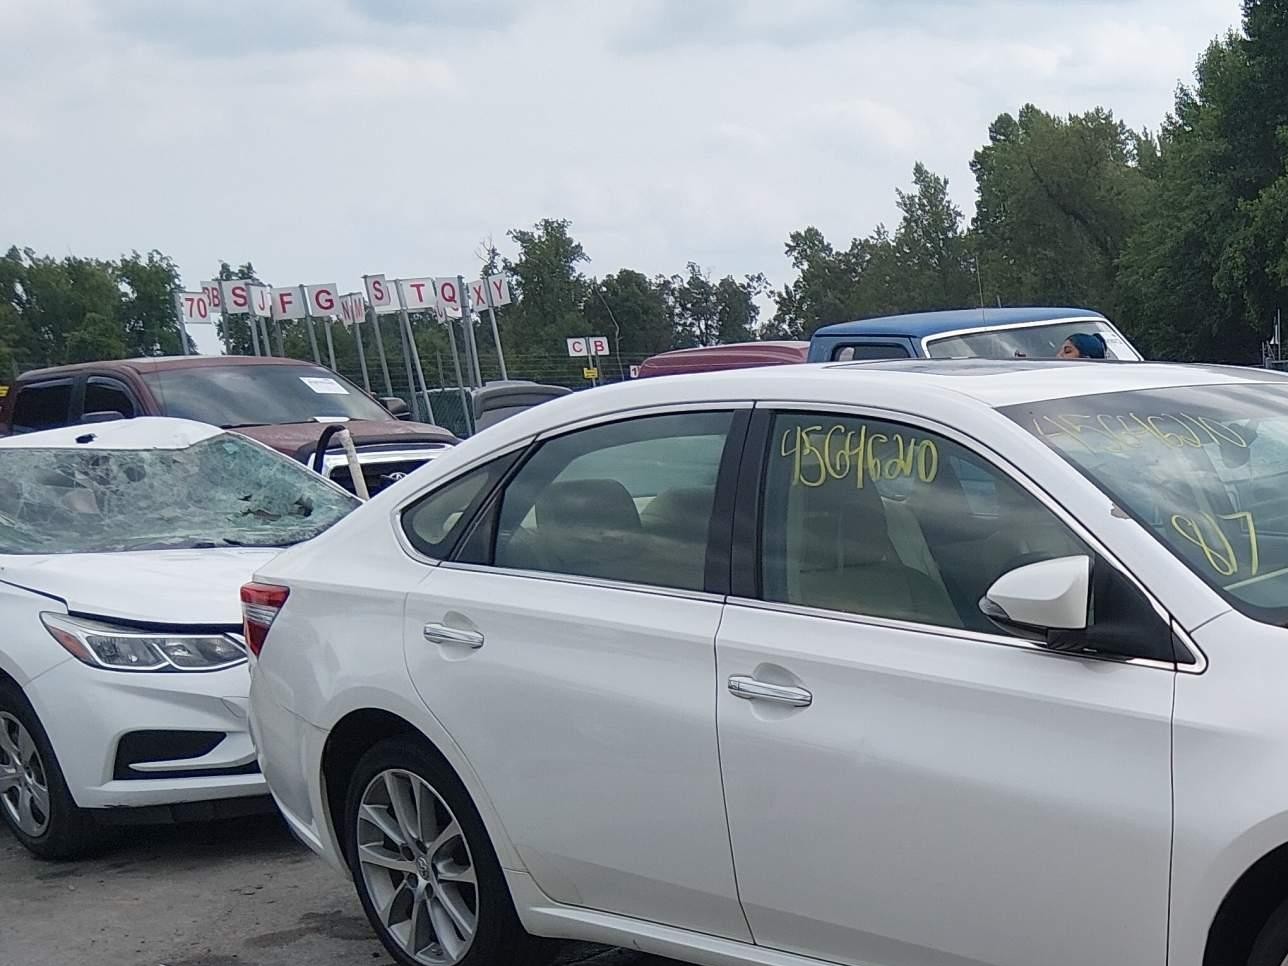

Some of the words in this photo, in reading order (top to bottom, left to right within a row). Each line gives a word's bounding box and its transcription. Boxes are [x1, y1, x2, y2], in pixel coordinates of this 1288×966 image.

[231, 286, 248, 307] S
[258, 289, 266, 311] J
[315, 289, 335, 310] G
[372, 280, 384, 301] S
[410, 283, 425, 303] T
[441, 282, 457, 304] Q
[472, 284, 486, 306] X
[492, 279, 503, 300] Y
[184, 297, 207, 319] 70
[279, 292, 293, 314] F
[572, 341, 583, 353] C
[594, 340, 605, 352] B
